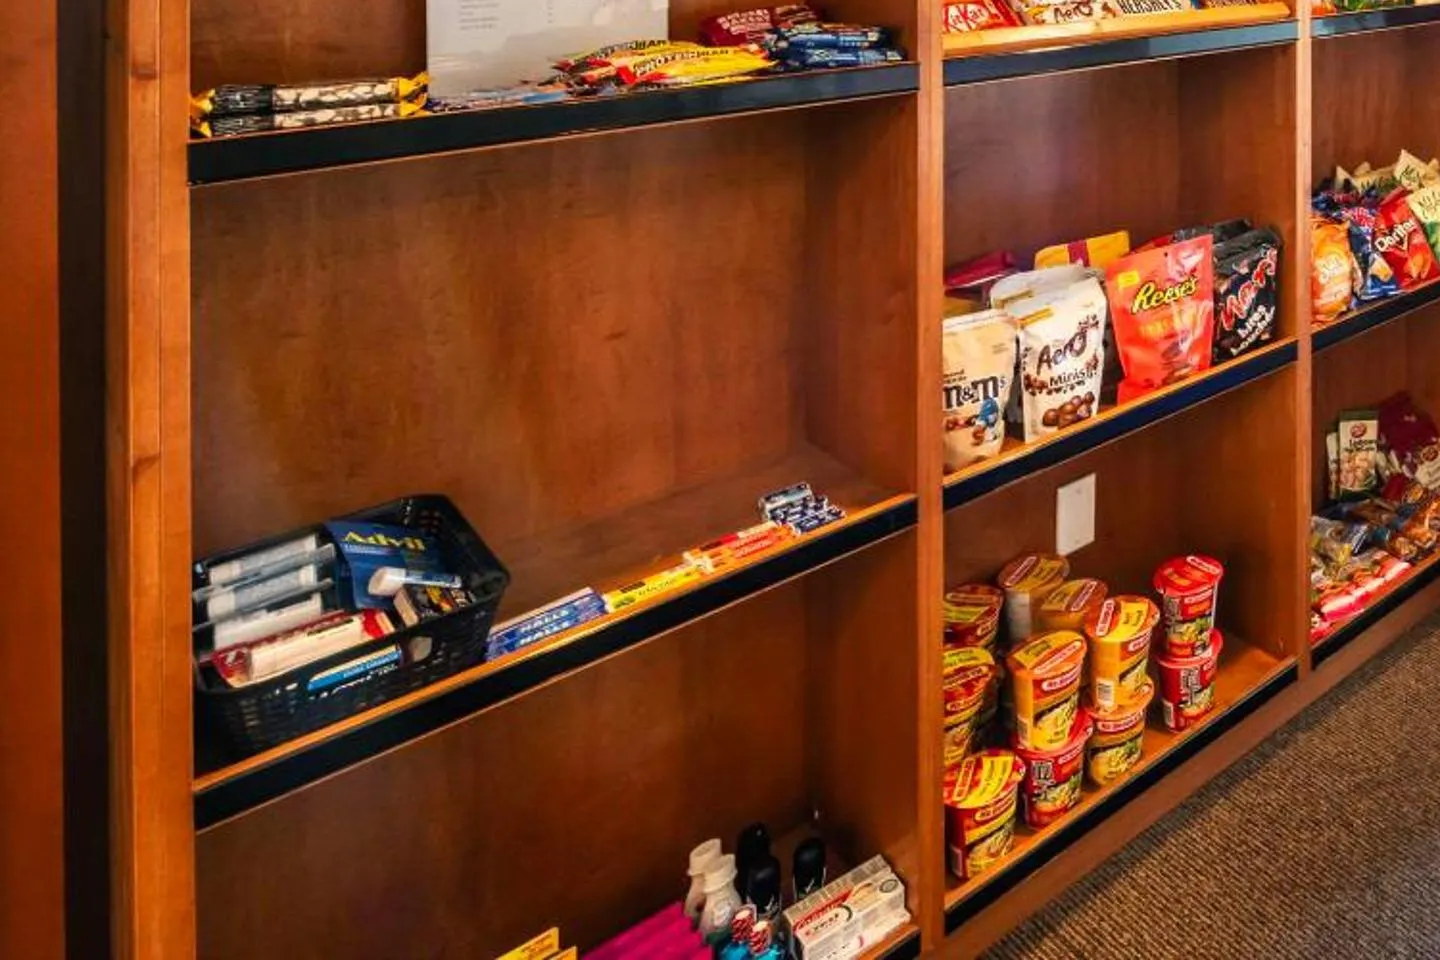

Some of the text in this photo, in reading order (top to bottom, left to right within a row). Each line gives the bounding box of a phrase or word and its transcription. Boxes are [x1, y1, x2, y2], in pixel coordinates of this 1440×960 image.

[1054, 0, 1093, 23] Aero
[1131, 273, 1200, 313] Reese's
[1036, 331, 1088, 376] Aero
